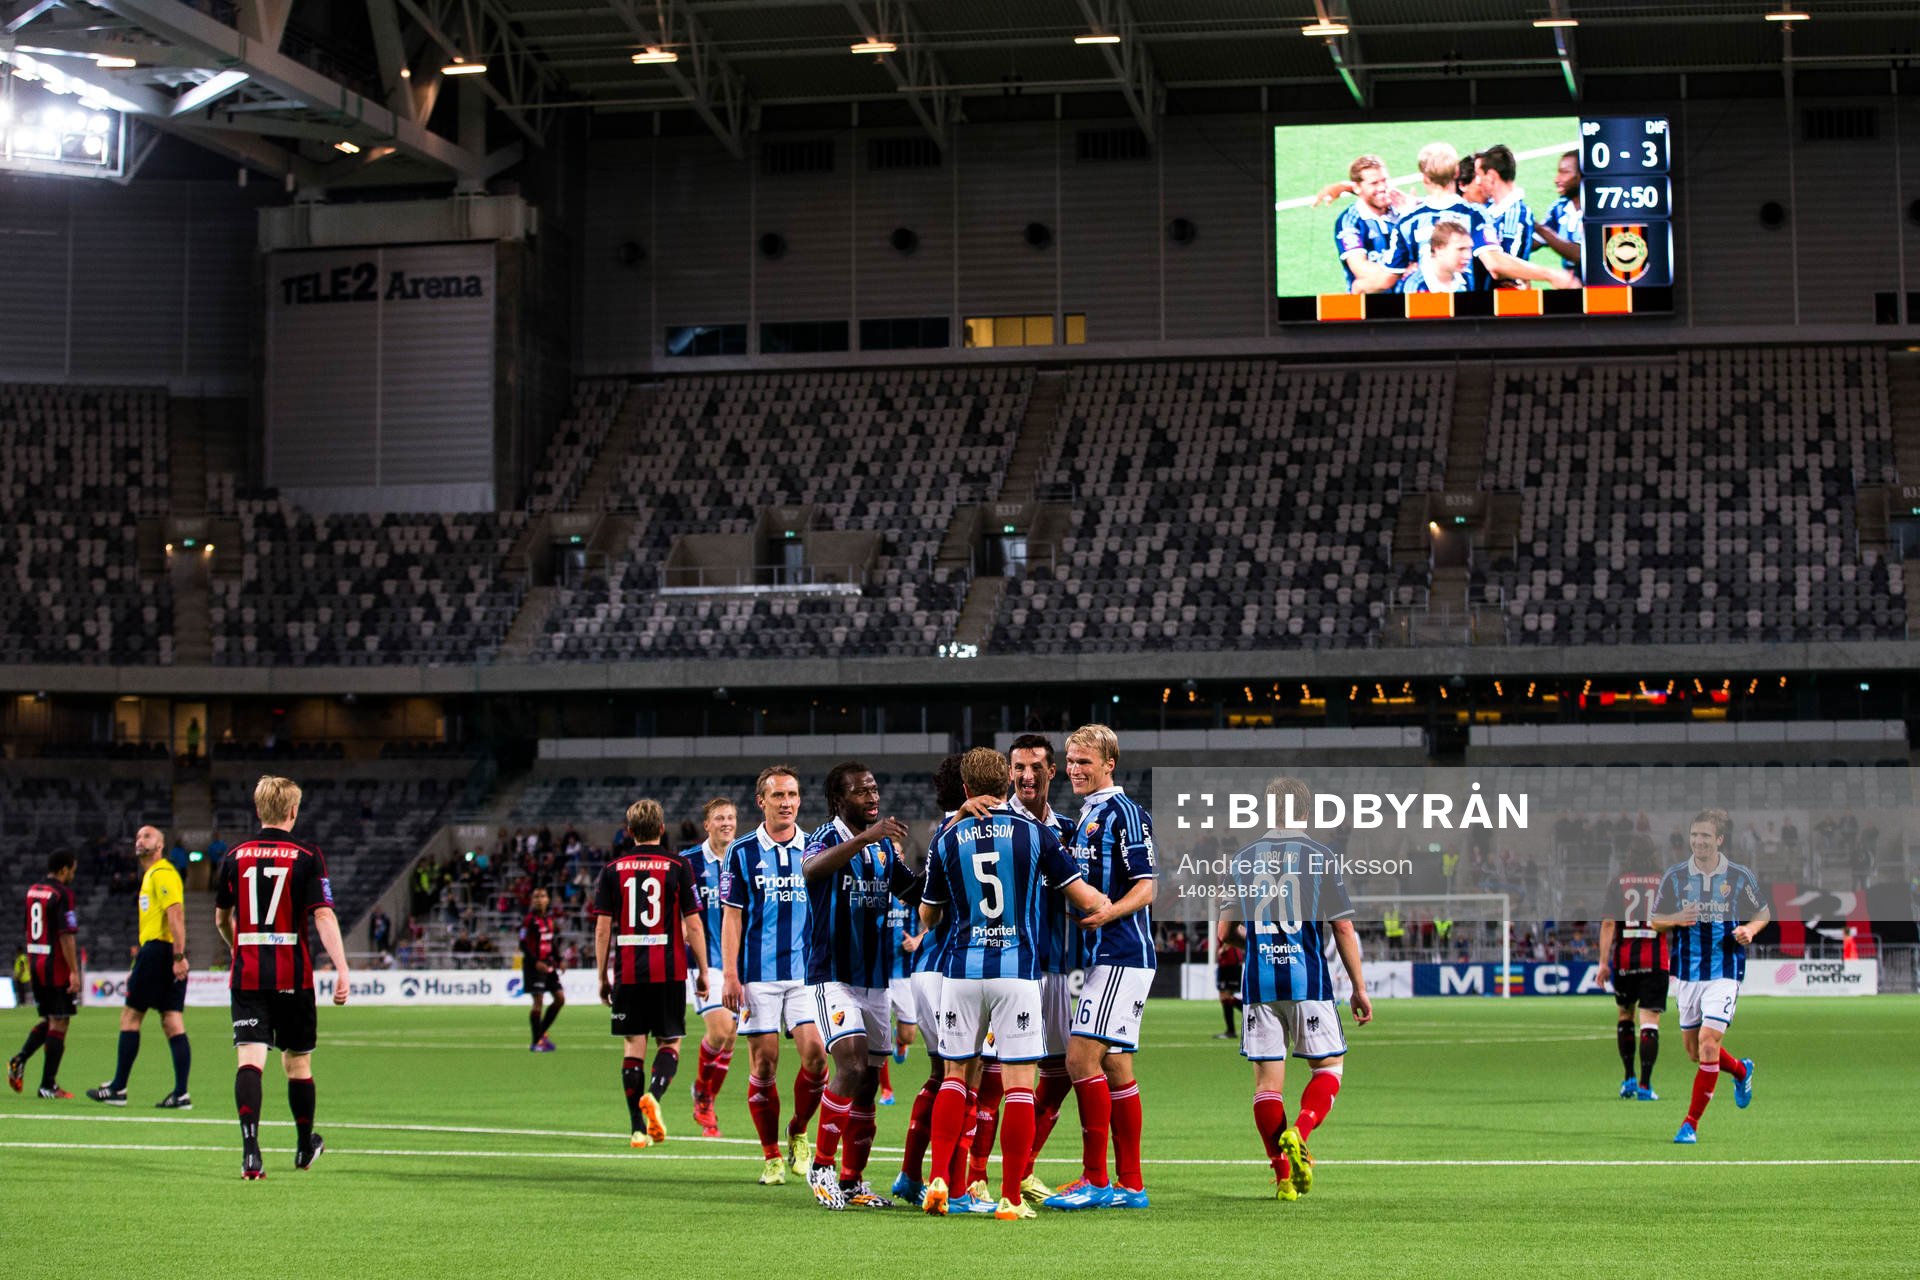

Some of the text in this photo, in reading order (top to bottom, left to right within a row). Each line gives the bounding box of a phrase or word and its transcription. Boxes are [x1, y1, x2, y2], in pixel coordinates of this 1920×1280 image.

[1591, 142, 1611, 169] 0
[1641, 141, 1658, 167] 3
[1595, 186, 1659, 208] 77:50
[281, 262, 483, 304] TELE2 Arena
[956, 824, 1014, 844] KARLSSON
[235, 849, 299, 860] BAUHAUS
[616, 861, 671, 872] BAUHAUS
[242, 866, 290, 926] 17
[972, 852, 1005, 919] 5
[623, 876, 662, 928] 13
[1254, 873, 1303, 934] 20
[1624, 888, 1655, 927] 21
[31, 902, 43, 940] 8
[972, 924, 1017, 938] Prioritet
[1259, 943, 1303, 954] Prioritet
[1265, 954, 1298, 965] Finans
[319, 978, 385, 995] Hsab
[424, 977, 492, 997] Husab
[1075, 999, 1092, 1025] 16
[1723, 996, 1732, 1014] 2
